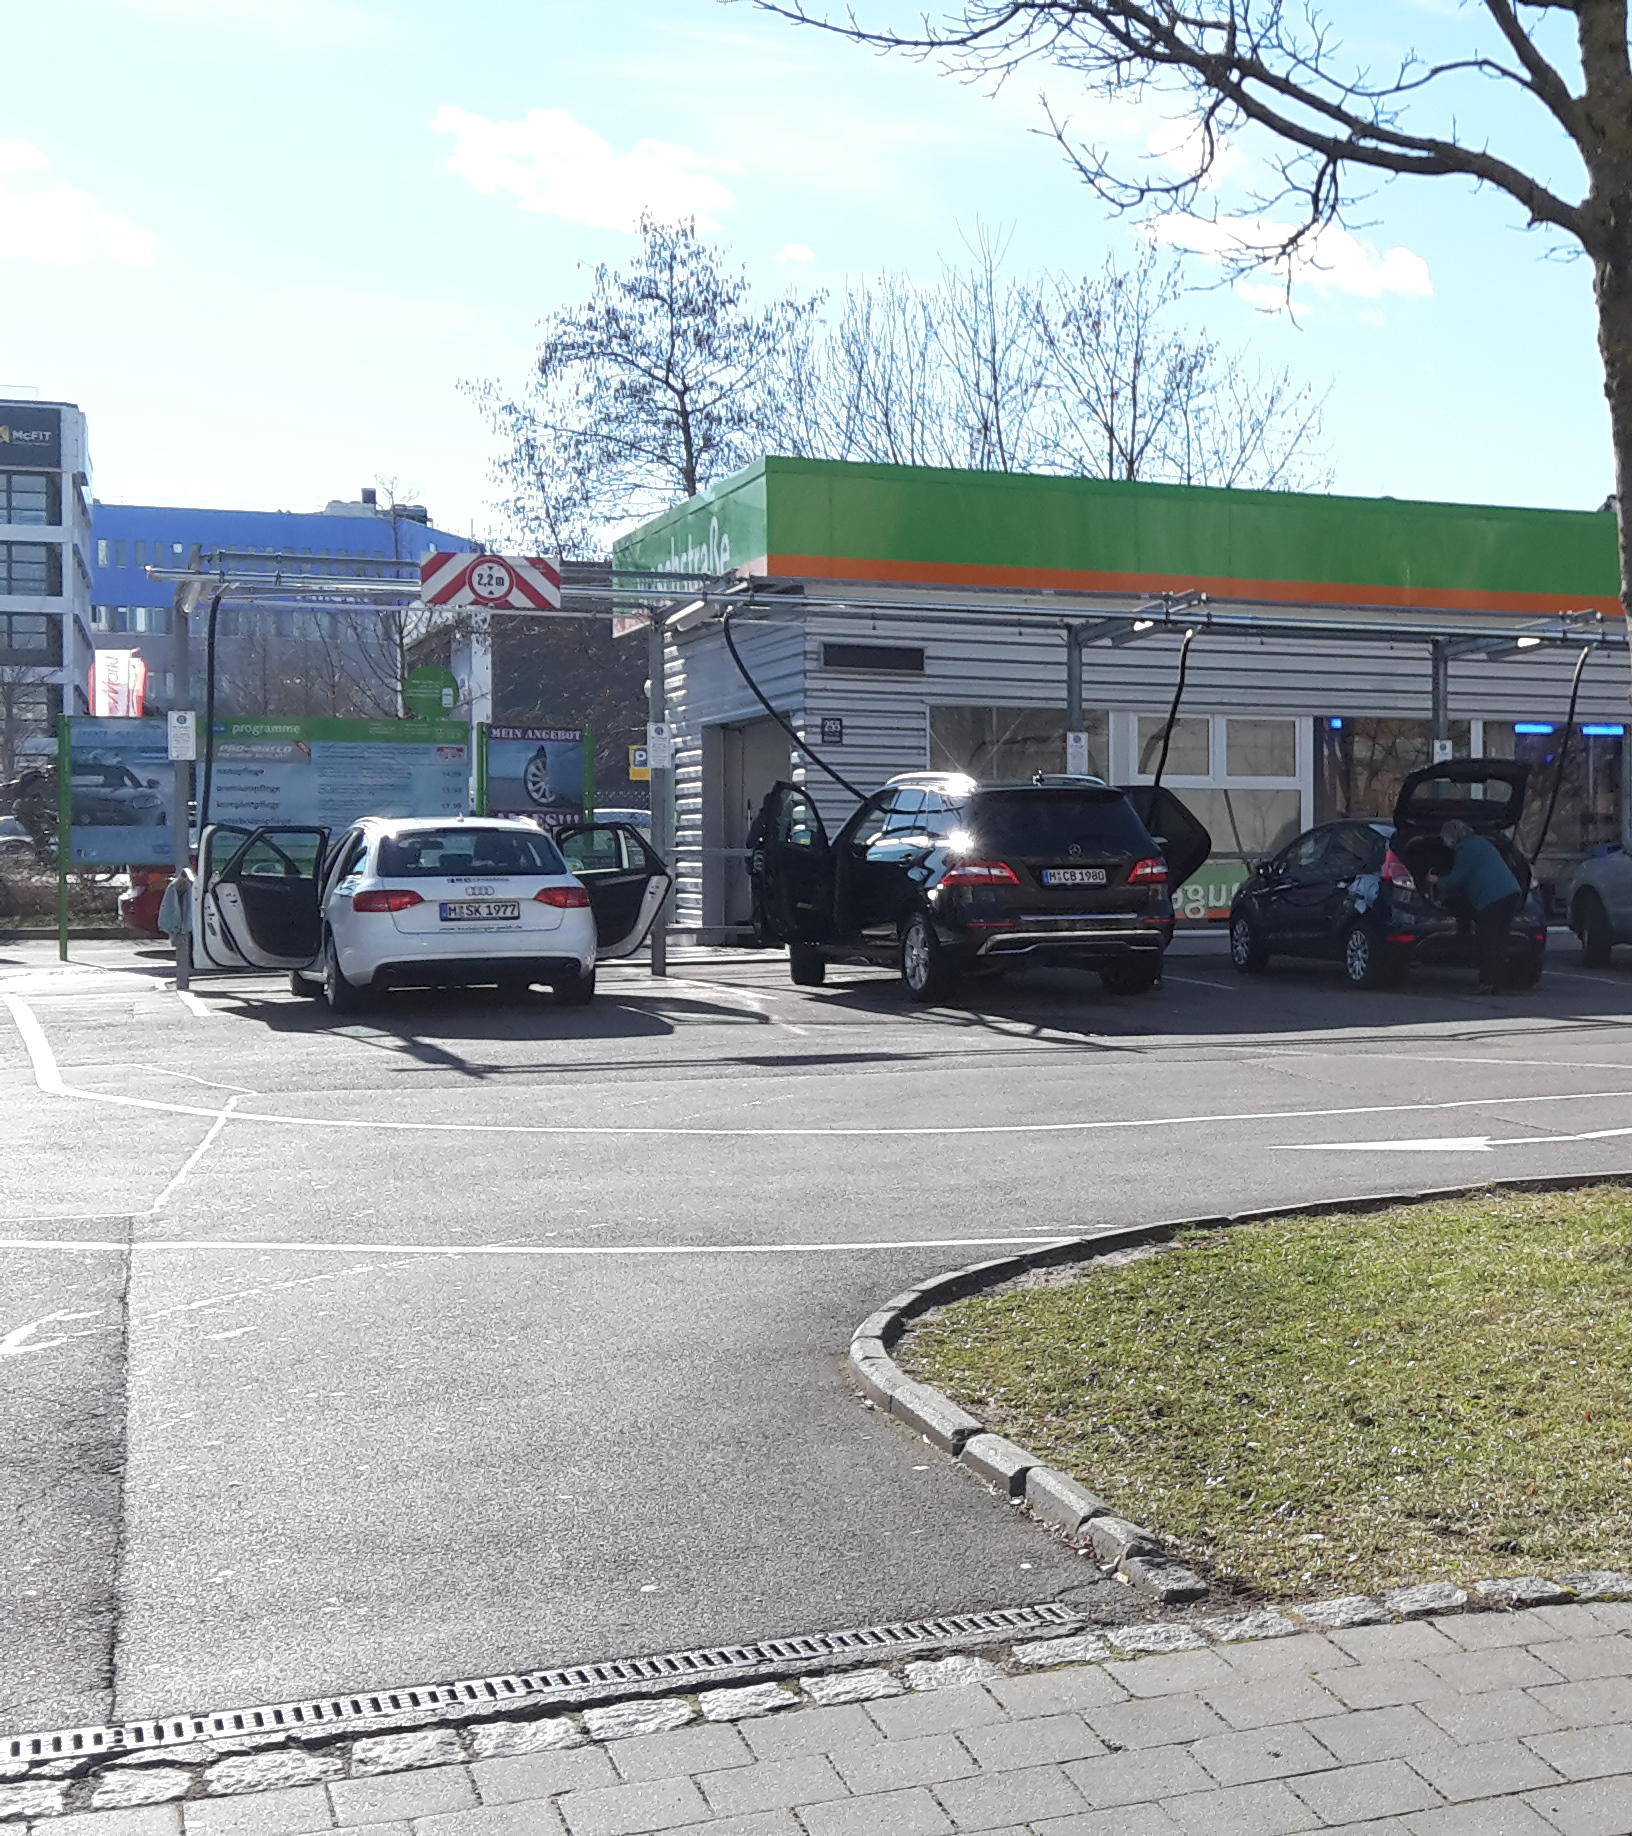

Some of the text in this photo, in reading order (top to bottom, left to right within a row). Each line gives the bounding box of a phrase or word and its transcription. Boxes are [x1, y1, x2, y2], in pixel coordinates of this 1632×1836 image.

[12, 430, 52, 441] McFIT
[232, 723, 301, 736] programme
[491, 728, 581, 740] MEIN ANGEBOT
[1079, 870, 1105, 881] 1980
[485, 904, 516, 916] 1977
